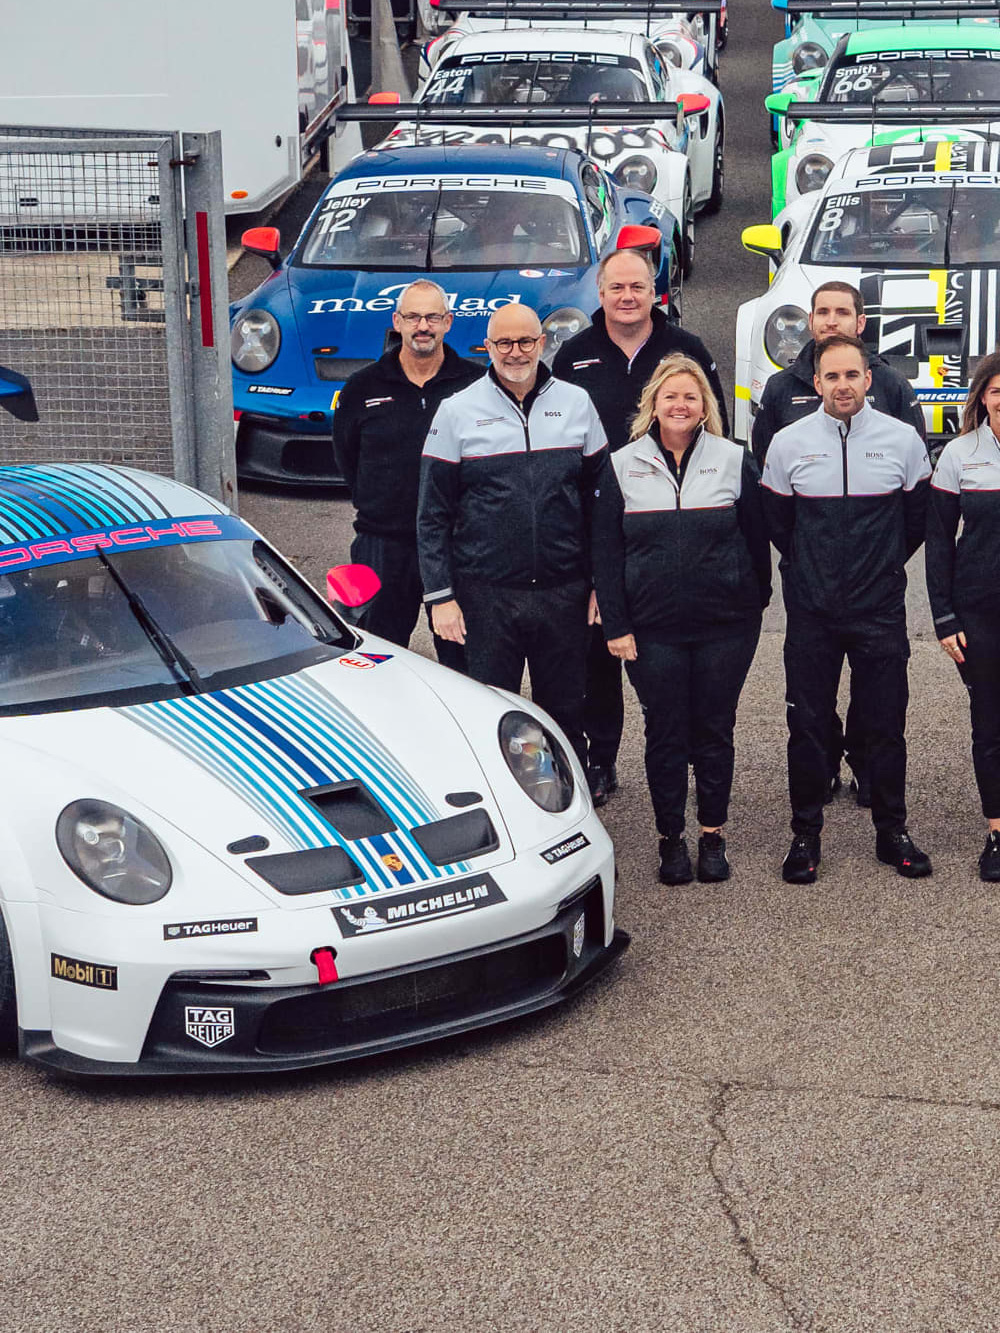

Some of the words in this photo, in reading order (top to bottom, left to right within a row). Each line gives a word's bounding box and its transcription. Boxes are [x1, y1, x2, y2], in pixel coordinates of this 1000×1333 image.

[461, 53, 619, 65] PORSCHE
[434, 67, 472, 79] Eaton
[835, 64, 877, 78] Smith
[427, 77, 466, 95] 44
[833, 75, 873, 94] 66
[356, 178, 547, 191] PORSCHE
[321, 196, 372, 211] Jelley
[825, 194, 860, 209] Ellis
[317, 210, 357, 234] 12
[818, 208, 846, 232] 8
[917, 393, 968, 401] MICHE
[387, 884, 489, 920] MICHELIN
[54, 957, 94, 984] Mobil
[189, 1009, 231, 1023] TAG
[189, 1024, 232, 1045] HEUER
